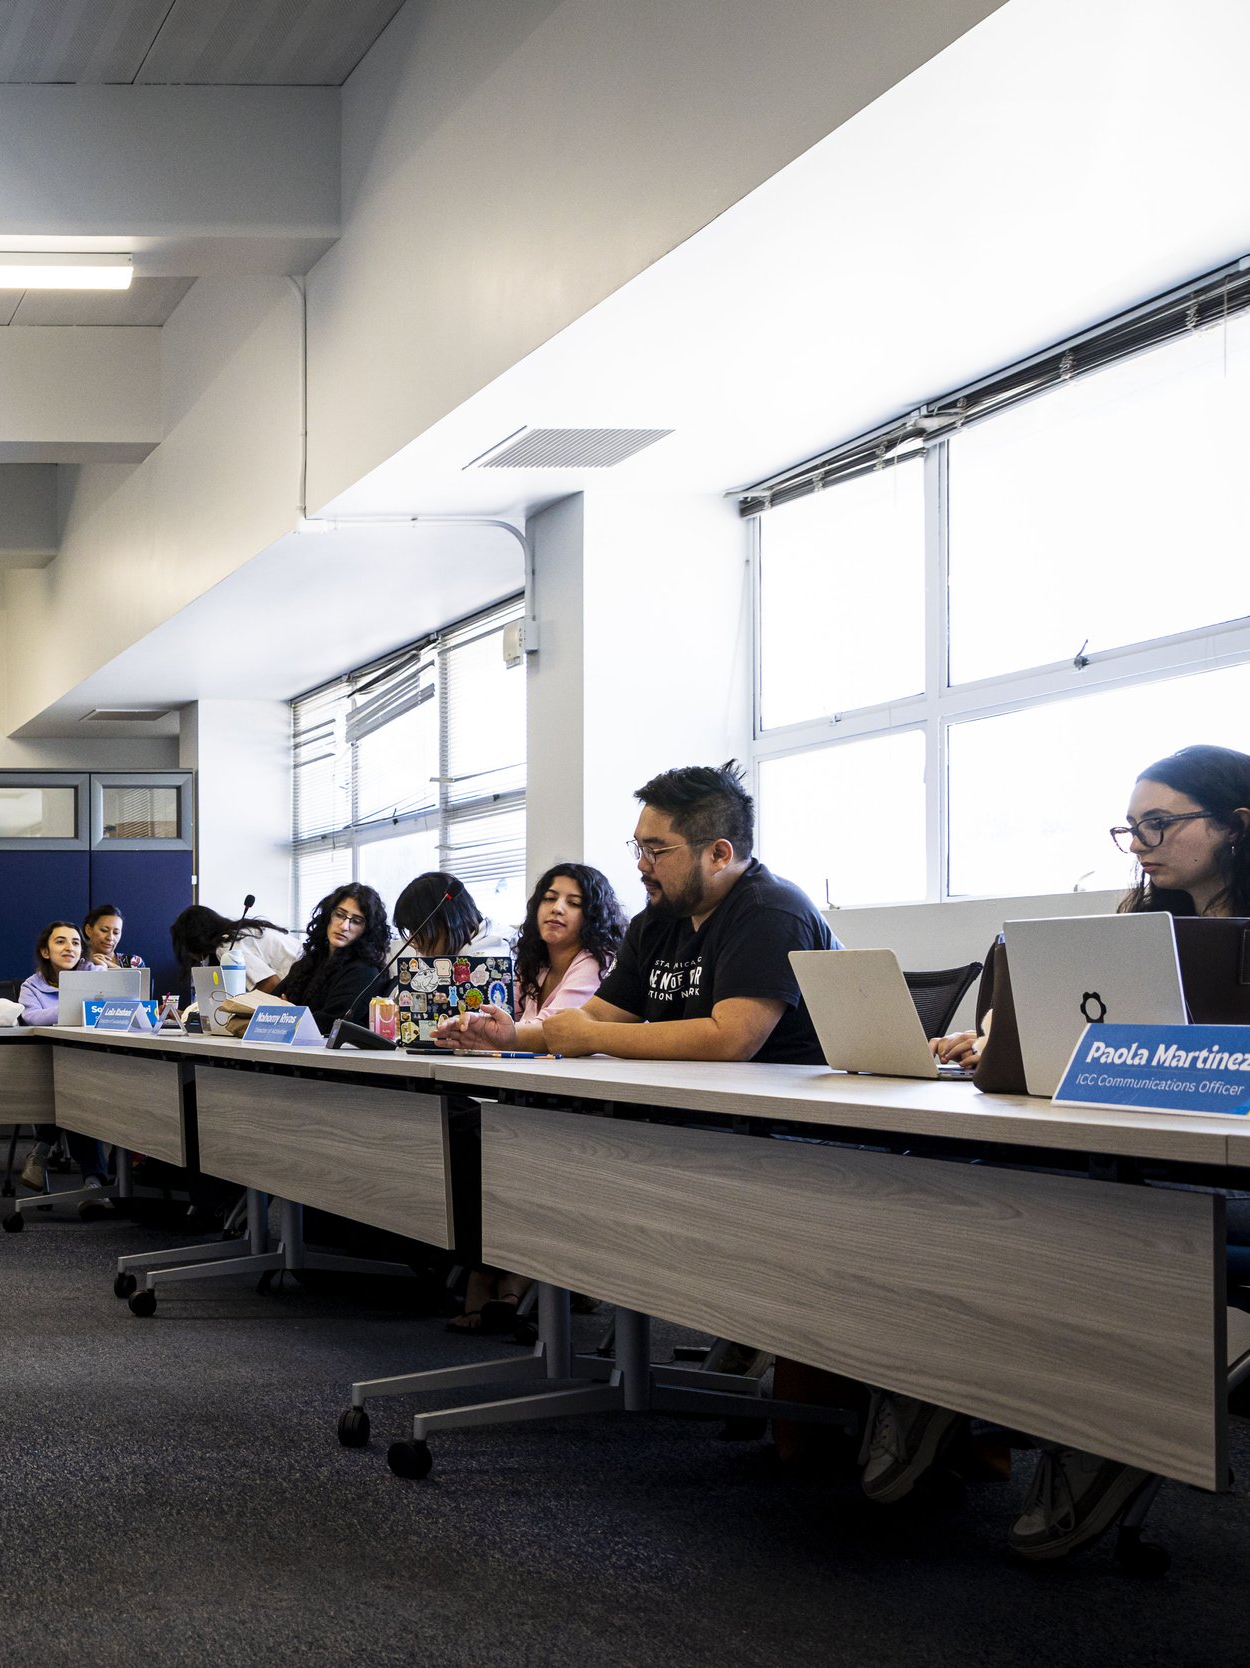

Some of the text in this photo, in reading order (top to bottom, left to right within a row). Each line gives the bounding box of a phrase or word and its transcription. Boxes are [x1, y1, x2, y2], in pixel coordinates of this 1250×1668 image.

[256, 1012, 297, 1025] Nahomy Rivas
[1086, 1041, 1250, 1071] Paola Martinez
[1076, 1074, 1245, 1096] ICC Communications Officer
